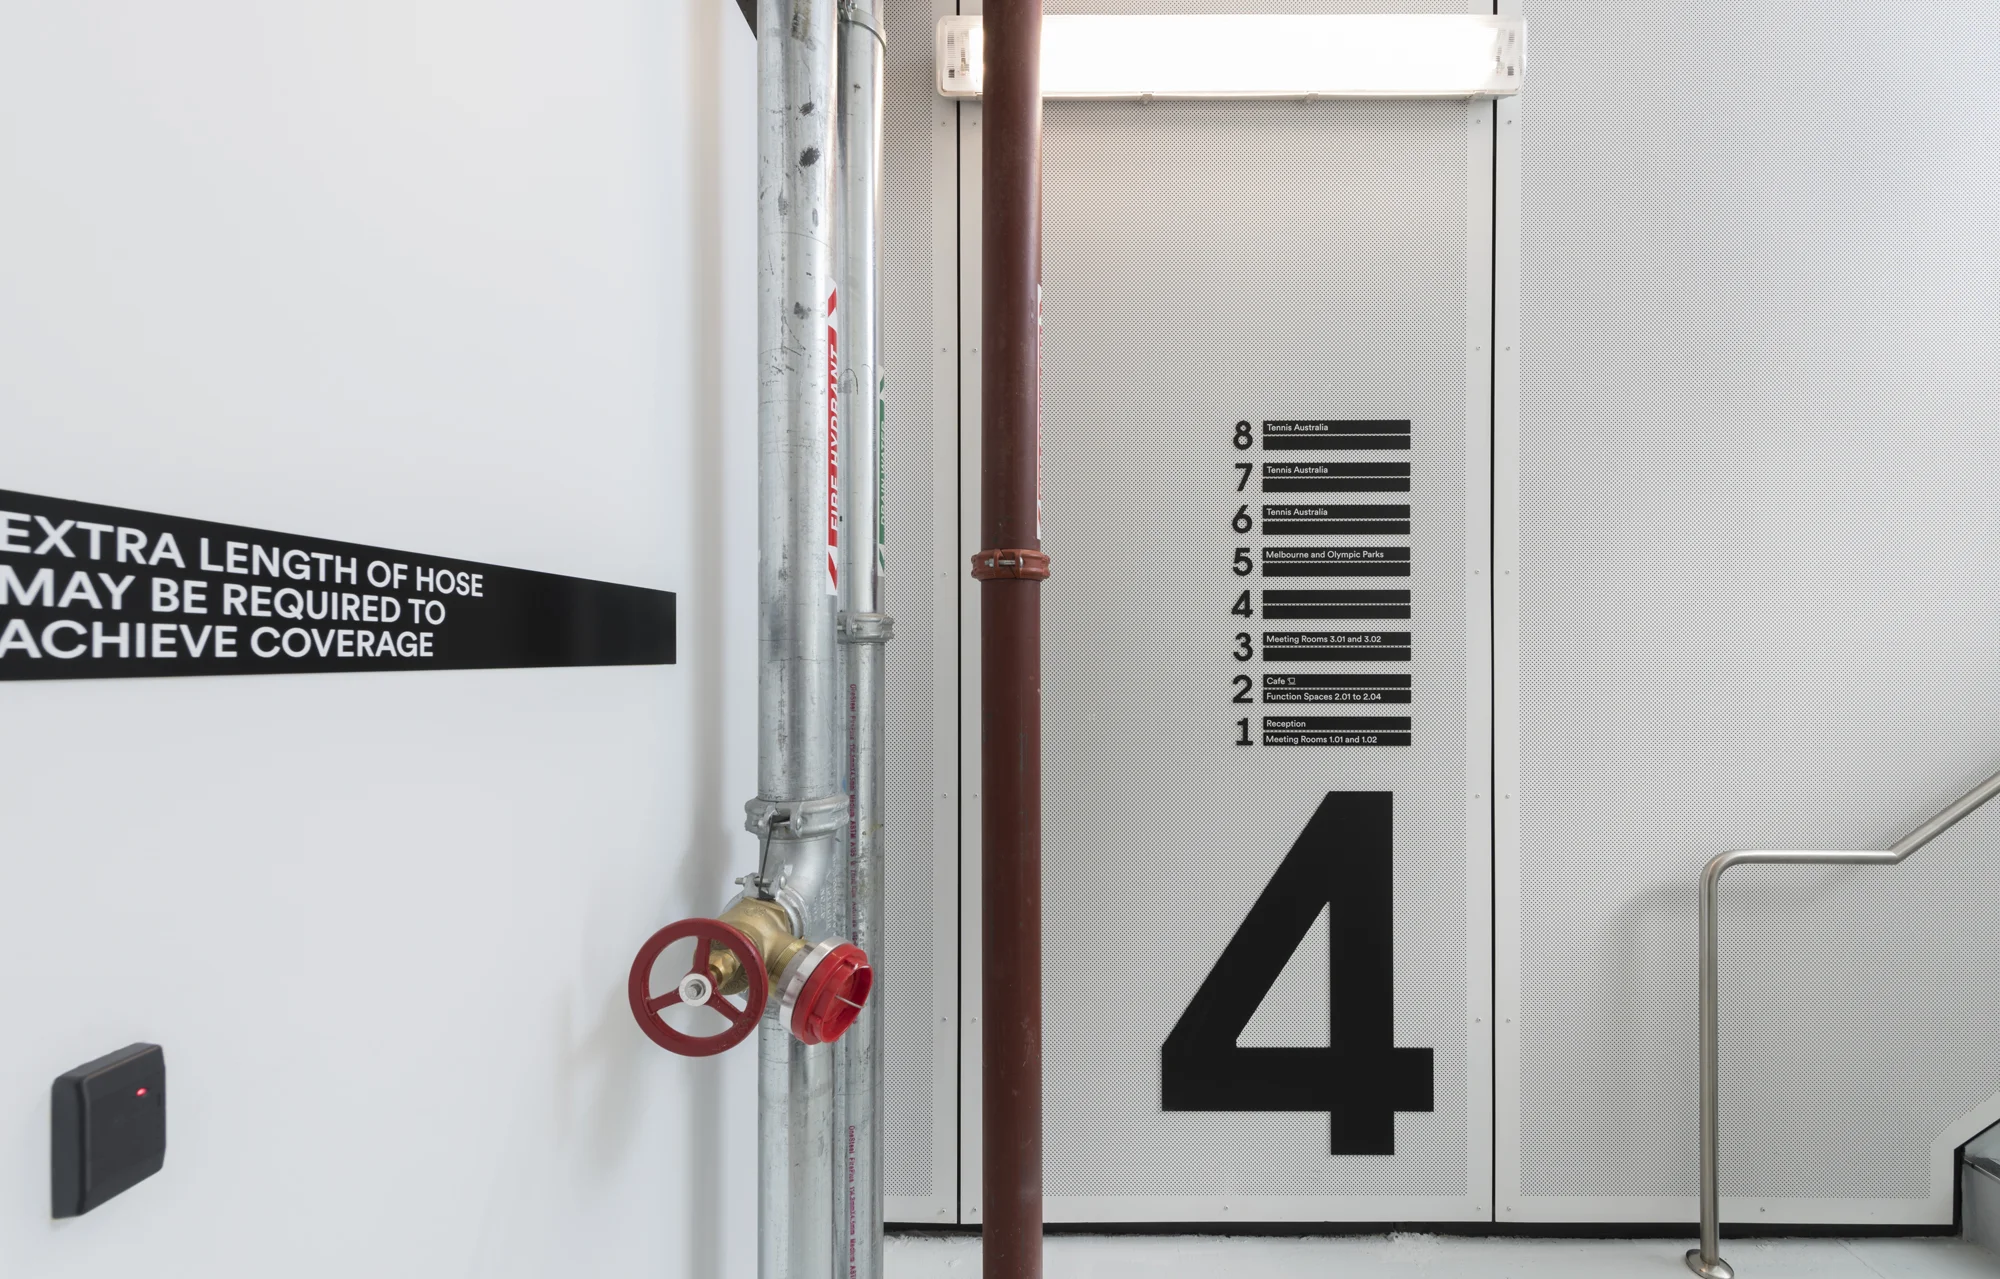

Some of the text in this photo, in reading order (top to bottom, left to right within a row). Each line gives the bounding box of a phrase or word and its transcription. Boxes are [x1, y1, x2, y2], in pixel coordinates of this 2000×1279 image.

[1232, 420, 1253, 451] 8
[1266, 422, 1329, 432] Tennis Australia
[1235, 463, 1253, 492] 7
[1266, 465, 1329, 474] Tennis Australia
[1232, 504, 1253, 534] 6
[1266, 507, 1328, 516] Tennis Australia
[0, 510, 484, 598] EXTRA LENGTH OF HOSE
[1232, 547, 1253, 577] 5
[1265, 550, 1385, 561] Melbourne and Olympic Parks
[0, 565, 446, 626] MAY BE REQUIRED TO
[1231, 589, 1253, 618] 4
[0, 618, 434, 659] ACHIEVE COVERAGE
[1233, 632, 1253, 662] 3
[1266, 634, 1382, 644] Meeting Rooms 3.01 and 3.02
[1232, 674, 1253, 704] 2
[1266, 676, 1286, 685] Cafe
[1266, 692, 1382, 702] Function Spaces 2.01 to 2.04
[1236, 717, 1254, 746] 1
[1266, 718, 1307, 729] Reception
[1265, 735, 1378, 745] Meeting Rooms 1.01 and 1.02
[1161, 790, 1435, 1156] 4
